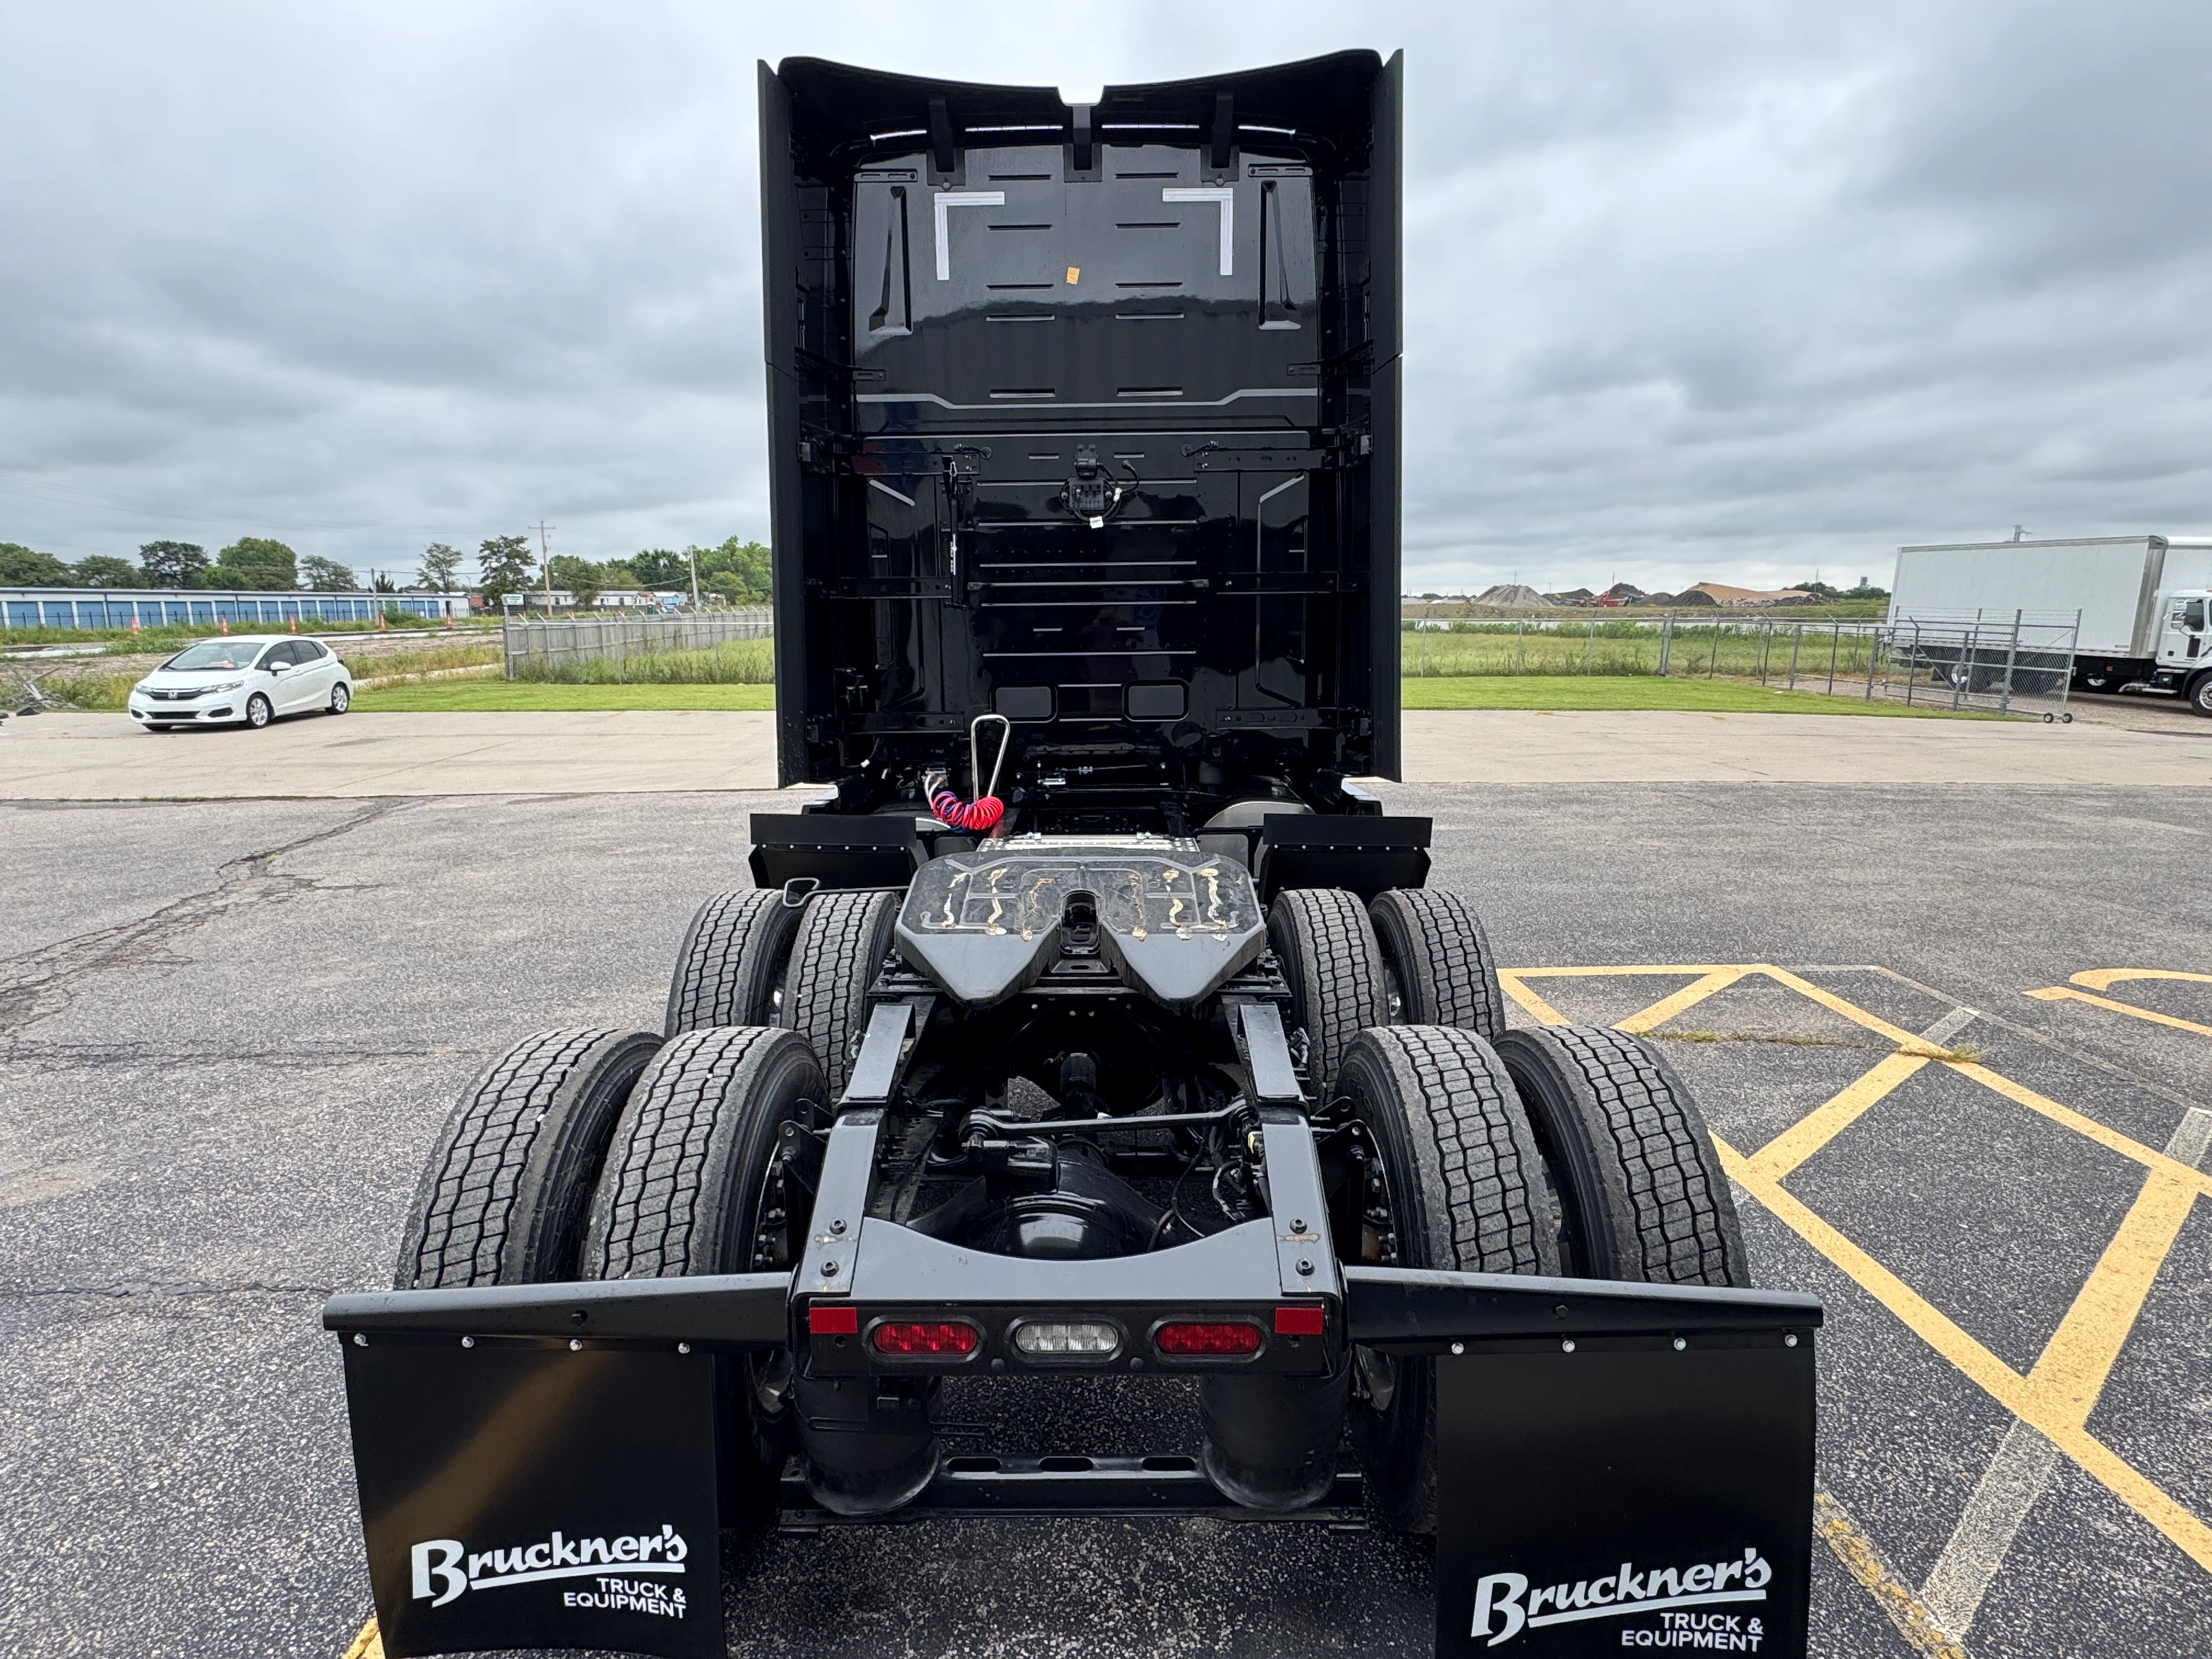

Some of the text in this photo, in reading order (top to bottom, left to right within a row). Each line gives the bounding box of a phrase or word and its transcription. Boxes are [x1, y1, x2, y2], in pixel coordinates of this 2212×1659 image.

[411, 1524, 688, 1608] Bruckner's
[596, 1577, 687, 1604] TRUCK &
[1471, 1548, 1772, 1647] Bruckner's
[563, 1592, 686, 1619] EQUIPMENT
[1660, 1613, 1764, 1635] TRUCK &
[1622, 1630, 1762, 1652] EQUIPMENT
